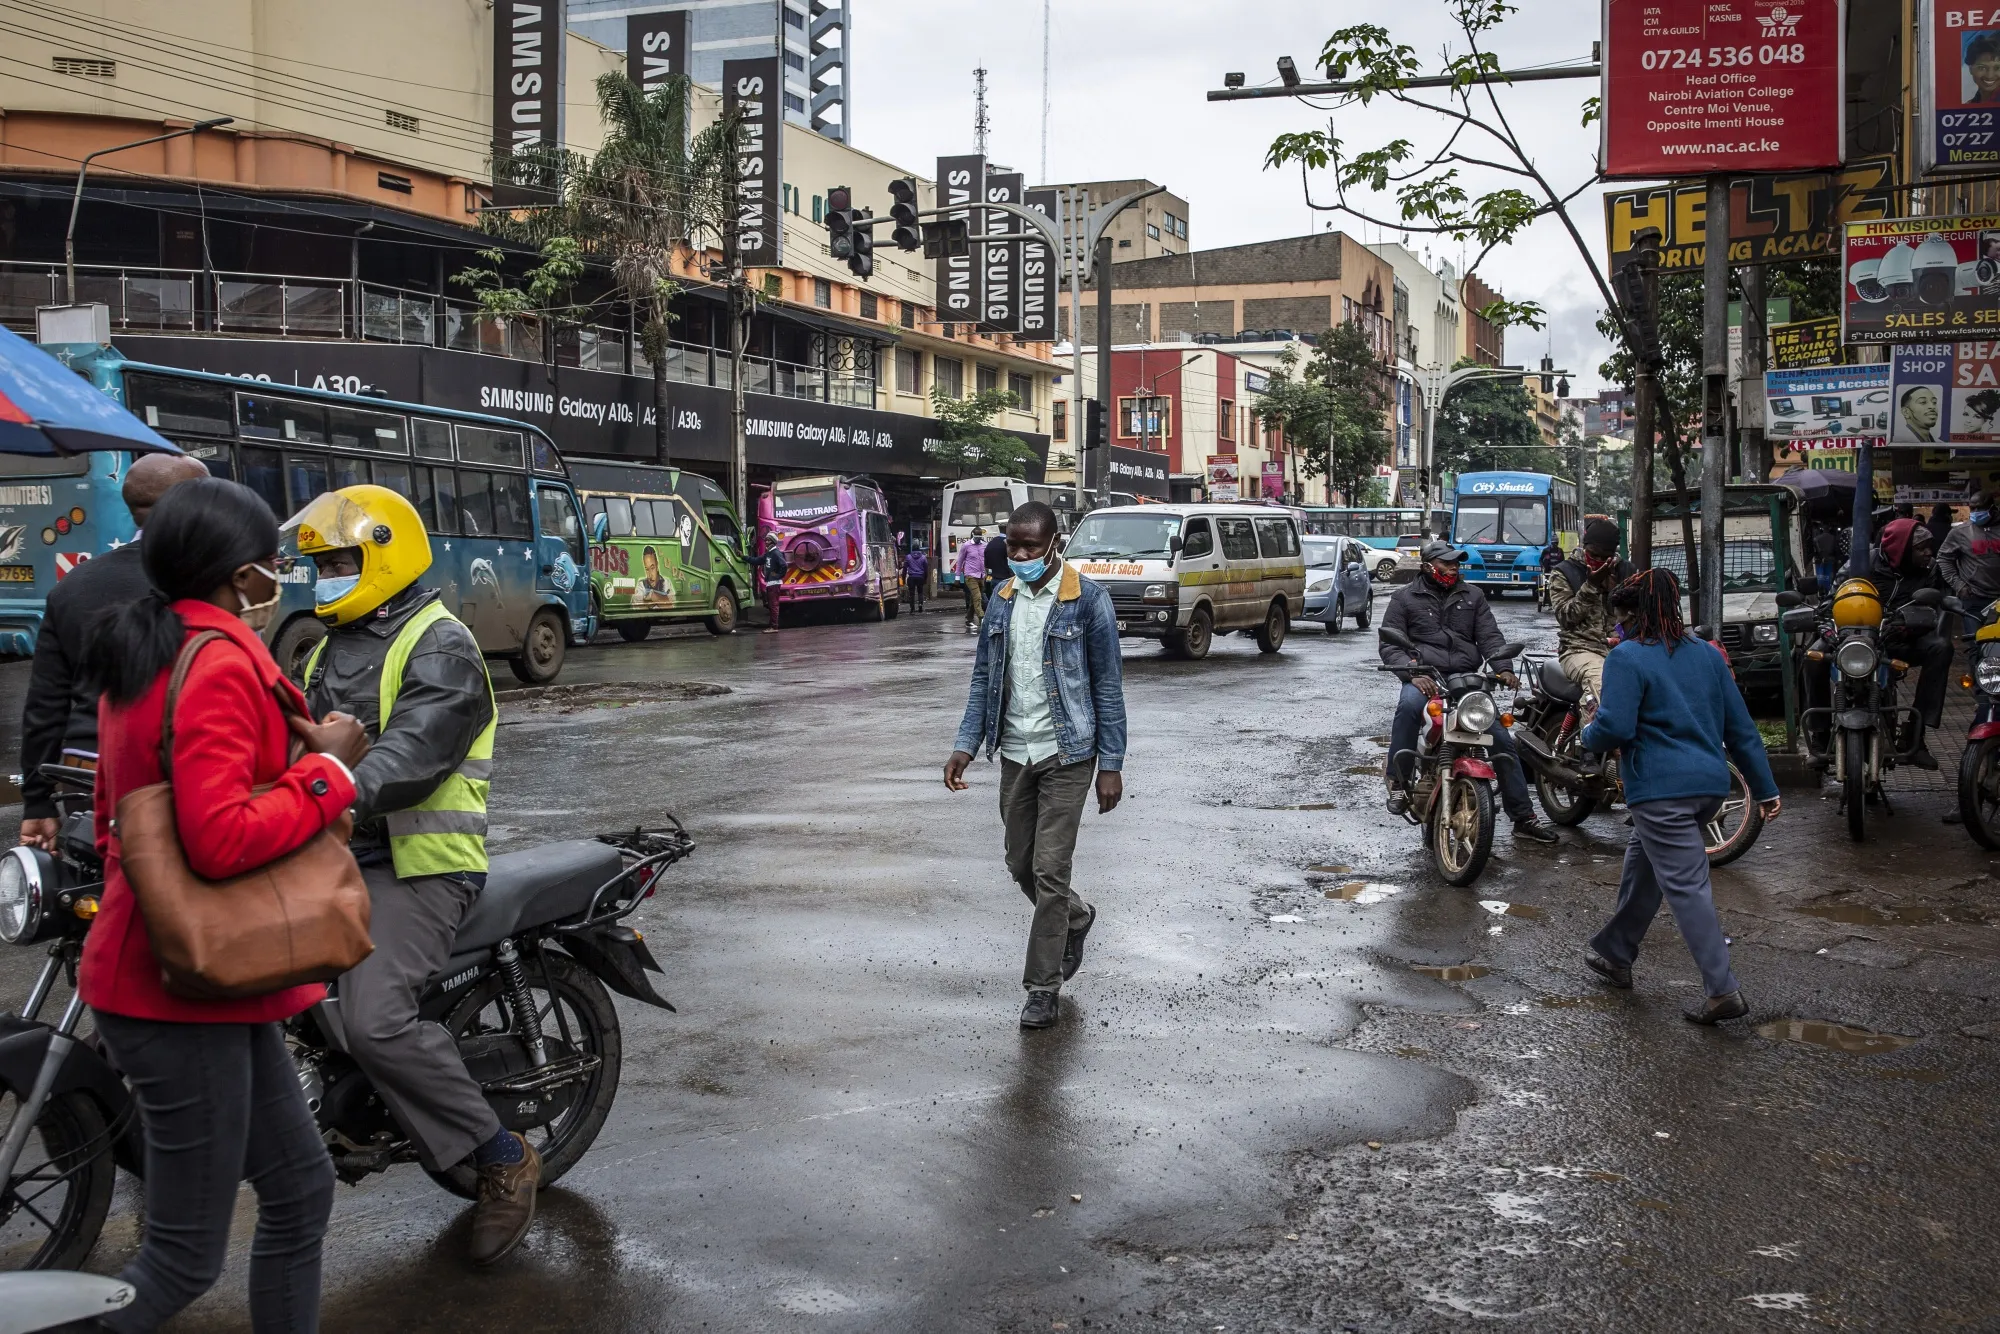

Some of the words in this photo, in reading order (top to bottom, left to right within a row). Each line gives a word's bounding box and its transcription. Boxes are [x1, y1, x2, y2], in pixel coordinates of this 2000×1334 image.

[1643, 7, 1661, 15] IATA
[1709, 4, 1731, 12] KNEC
[1709, 14, 1741, 22] KASNEB
[1643, 28, 1661, 36] CITY
[1670, 26, 1700, 35] GUILDS
[1761, 26, 1796, 38] IATA
[1641, 48, 1702, 70] 0724
[1708, 46, 1753, 67] 536
[1758, 43, 1805, 65] 048
[1686, 74, 1716, 85] Head
[1720, 73, 1756, 84] Office
[1649, 90, 1692, 102] Nairobi
[1695, 88, 1744, 99] Aviation
[1748, 86, 1794, 99] College
[1664, 104, 1704, 115] Centre
[1707, 103, 1729, 113] Moi
[1734, 103, 1774, 114] Venue,
[1647, 119, 1701, 132] Opposite
[1704, 117, 1742, 128] Imenti
[1746, 116, 1784, 127] House
[1941, 112, 1993, 128] 0722
[1662, 138, 1780, 155] www.nac.ac.ke
[1943, 132, 1994, 147] 0727
[1866, 219, 1955, 235] HIKVISION
[1959, 218, 1998, 229] Cctv
[947, 169, 971, 310] SAUNG
[1850, 238, 1881, 247] REAL.
[1882, 234, 1931, 245] TRUSTED
[987, 186, 1010, 320] SAMSUNG
[1885, 312, 1945, 328] SALES
[1952, 311, 1968, 325] &
[1864, 331, 1899, 340] FLOOR
[1901, 330, 1917, 338] RM
[1779, 340, 1836, 355] DRIVING
[1779, 347, 1838, 363] ACADEMY
[1896, 344, 1952, 356] BARBER
[1809, 357, 1831, 365] FLOOR
[1902, 361, 1946, 373] SHOP
[1957, 363, 1999, 386] SA
[1788, 383, 1824, 392] Sales
[1826, 382, 1837, 390] &
[480, 386, 554, 414] SAMSUNG
[559, 397, 607, 426] Galaxy
[608, 402, 633, 423] A10s
[677, 410, 702, 430] A30s
[745, 418, 793, 439] SAMSUNG
[796, 423, 828, 447] Galaxy
[828, 426, 846, 443] A10s
[852, 429, 870, 446] A20s
[875, 432, 893, 448] A30s
[1788, 439, 1817, 452] KEY
[1119, 462, 1134, 479] Galaxy
[1472, 482, 1495, 494] City
[1495, 482, 1534, 493] Shuttle
[775, 508, 813, 518] HANNOVER
[813, 505, 838, 515] TRANS
[589, 545, 629, 577] RISS
[1117, 564, 1144, 576] SACCO
[441, 965, 480, 993] YAMAHA
